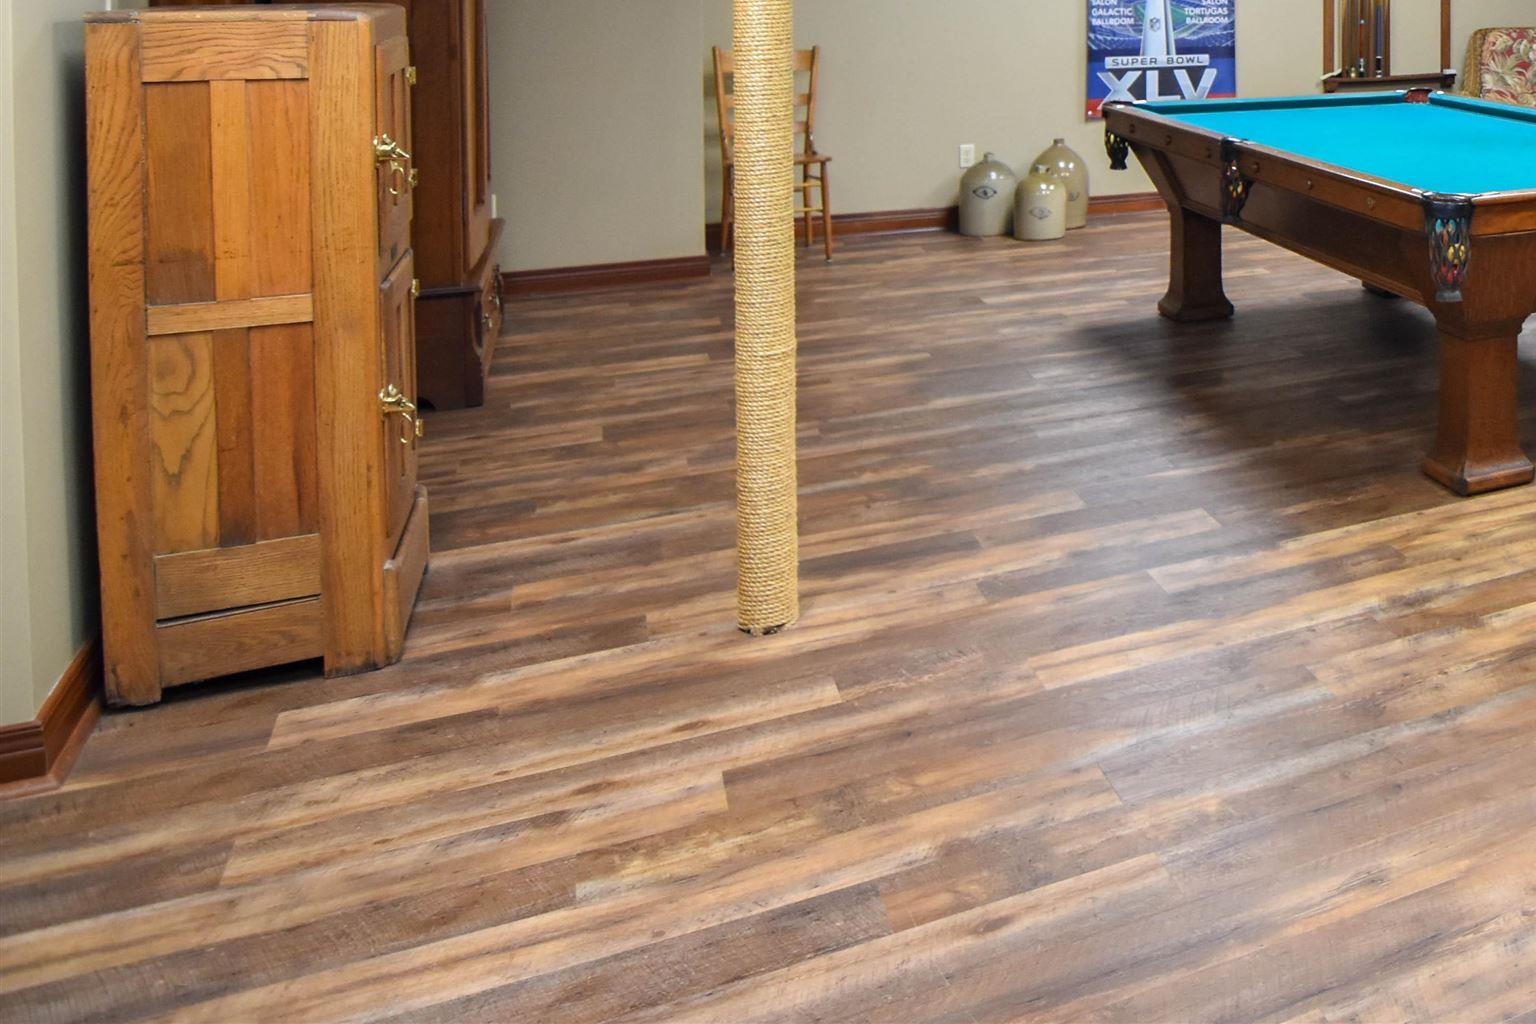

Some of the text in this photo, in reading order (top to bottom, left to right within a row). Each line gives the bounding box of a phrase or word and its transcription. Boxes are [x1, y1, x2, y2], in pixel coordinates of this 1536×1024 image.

[1092, 8, 1133, 16] GALACTIC
[1184, 7, 1228, 15] TORTUGAS
[1092, 18, 1134, 26] BALLROOM
[1112, 56, 1204, 67] SUPER BOWL
[1097, 68, 1217, 109] XLV
